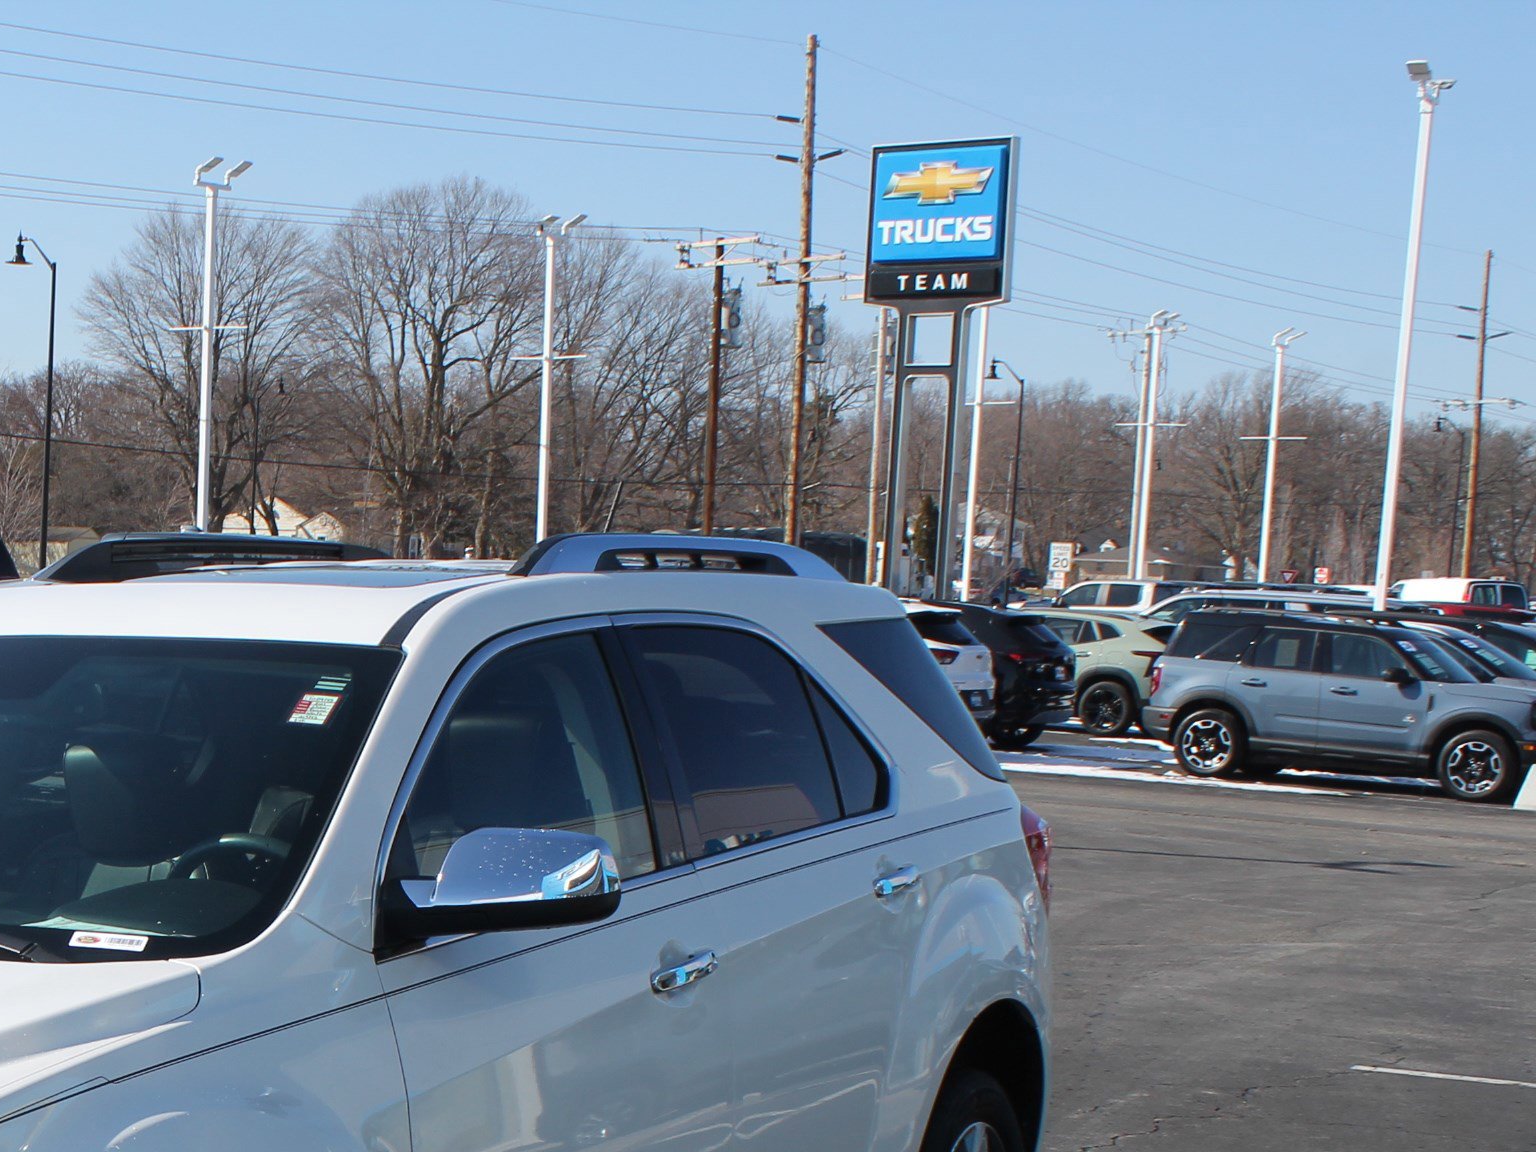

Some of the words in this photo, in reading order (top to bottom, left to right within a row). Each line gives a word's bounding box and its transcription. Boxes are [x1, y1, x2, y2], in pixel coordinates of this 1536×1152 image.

[877, 215, 993, 246] TRUCKS
[897, 272, 969, 292] TEAM
[1052, 557, 1069, 568] 20
